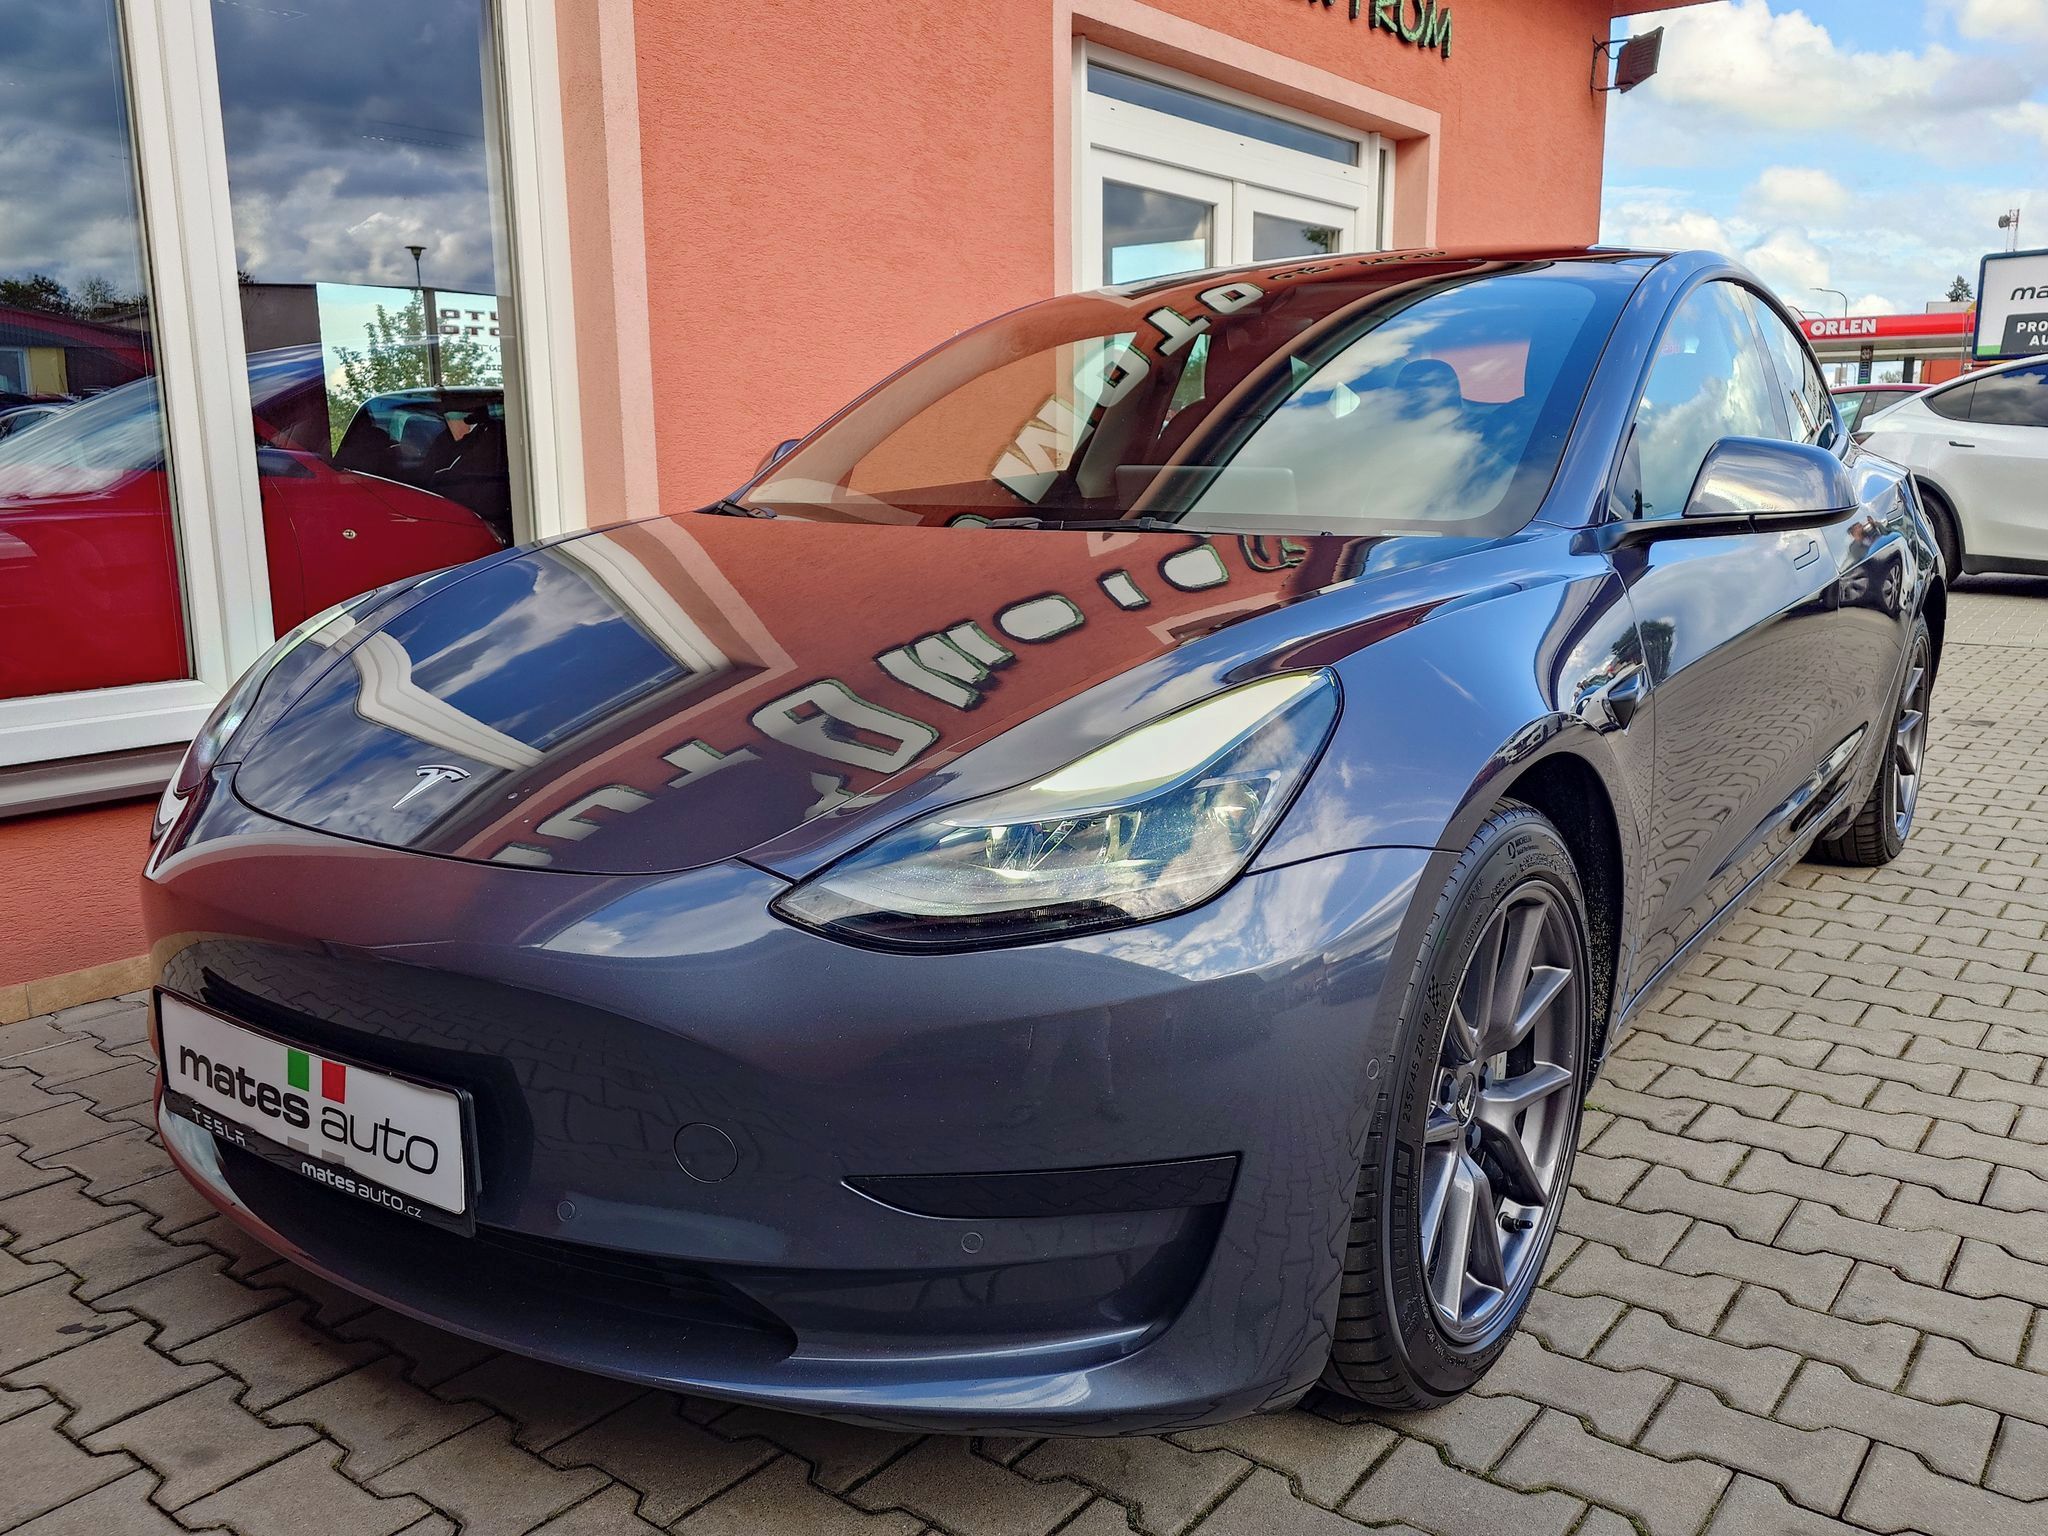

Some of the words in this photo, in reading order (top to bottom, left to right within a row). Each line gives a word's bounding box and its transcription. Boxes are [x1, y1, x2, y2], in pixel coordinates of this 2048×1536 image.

[1809, 318, 1877, 337] ORLEN
[179, 1044, 311, 1130] mates
[320, 1103, 440, 1176] auto
[191, 1107, 247, 1148] TESLA
